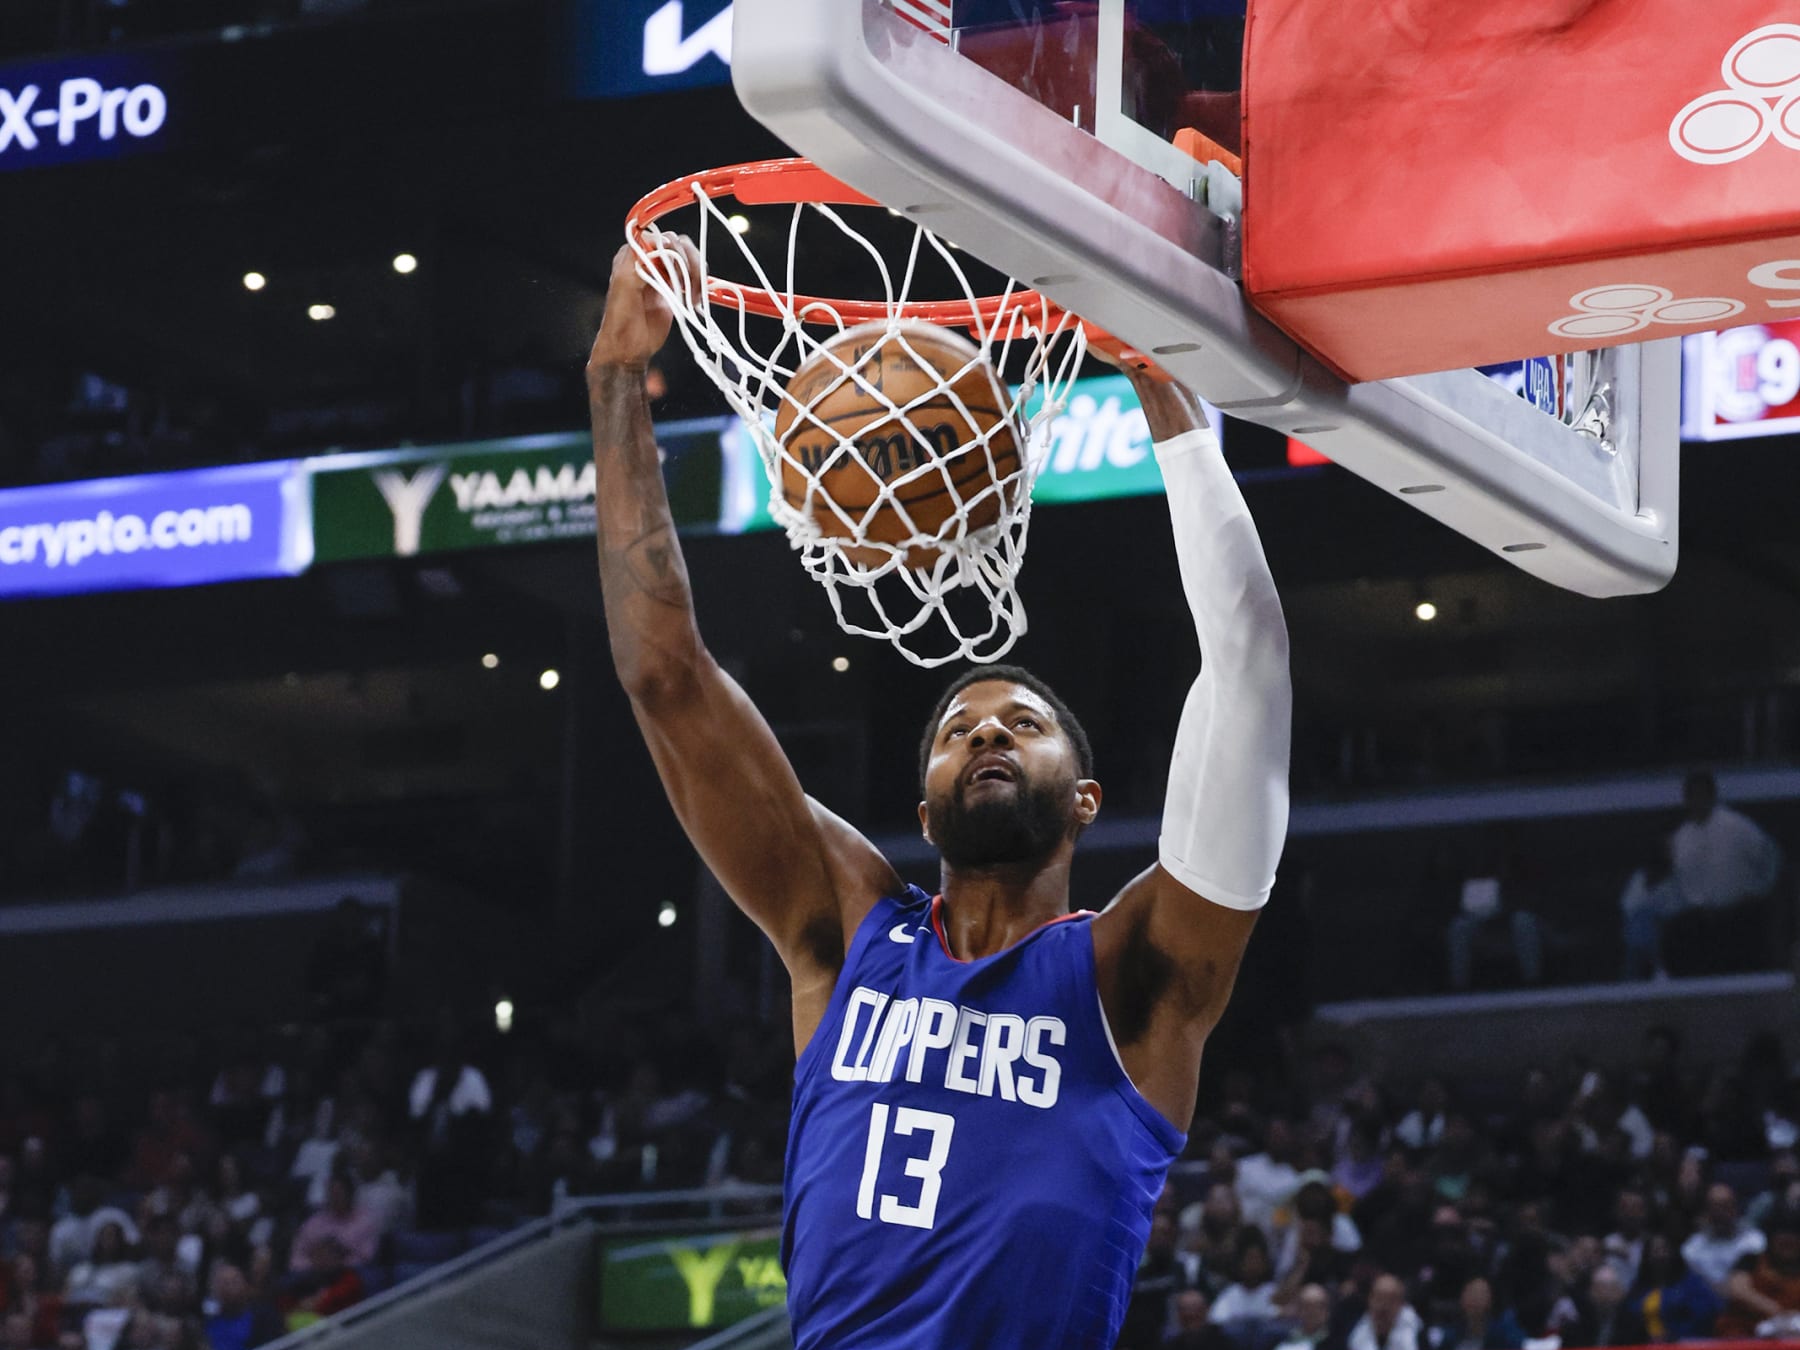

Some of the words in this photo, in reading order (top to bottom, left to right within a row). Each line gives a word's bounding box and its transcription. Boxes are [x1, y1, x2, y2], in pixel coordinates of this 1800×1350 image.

[0, 503, 251, 568] crypto.com
[831, 986, 1066, 1109] CLIPPERS
[856, 1102, 956, 1229] 13
